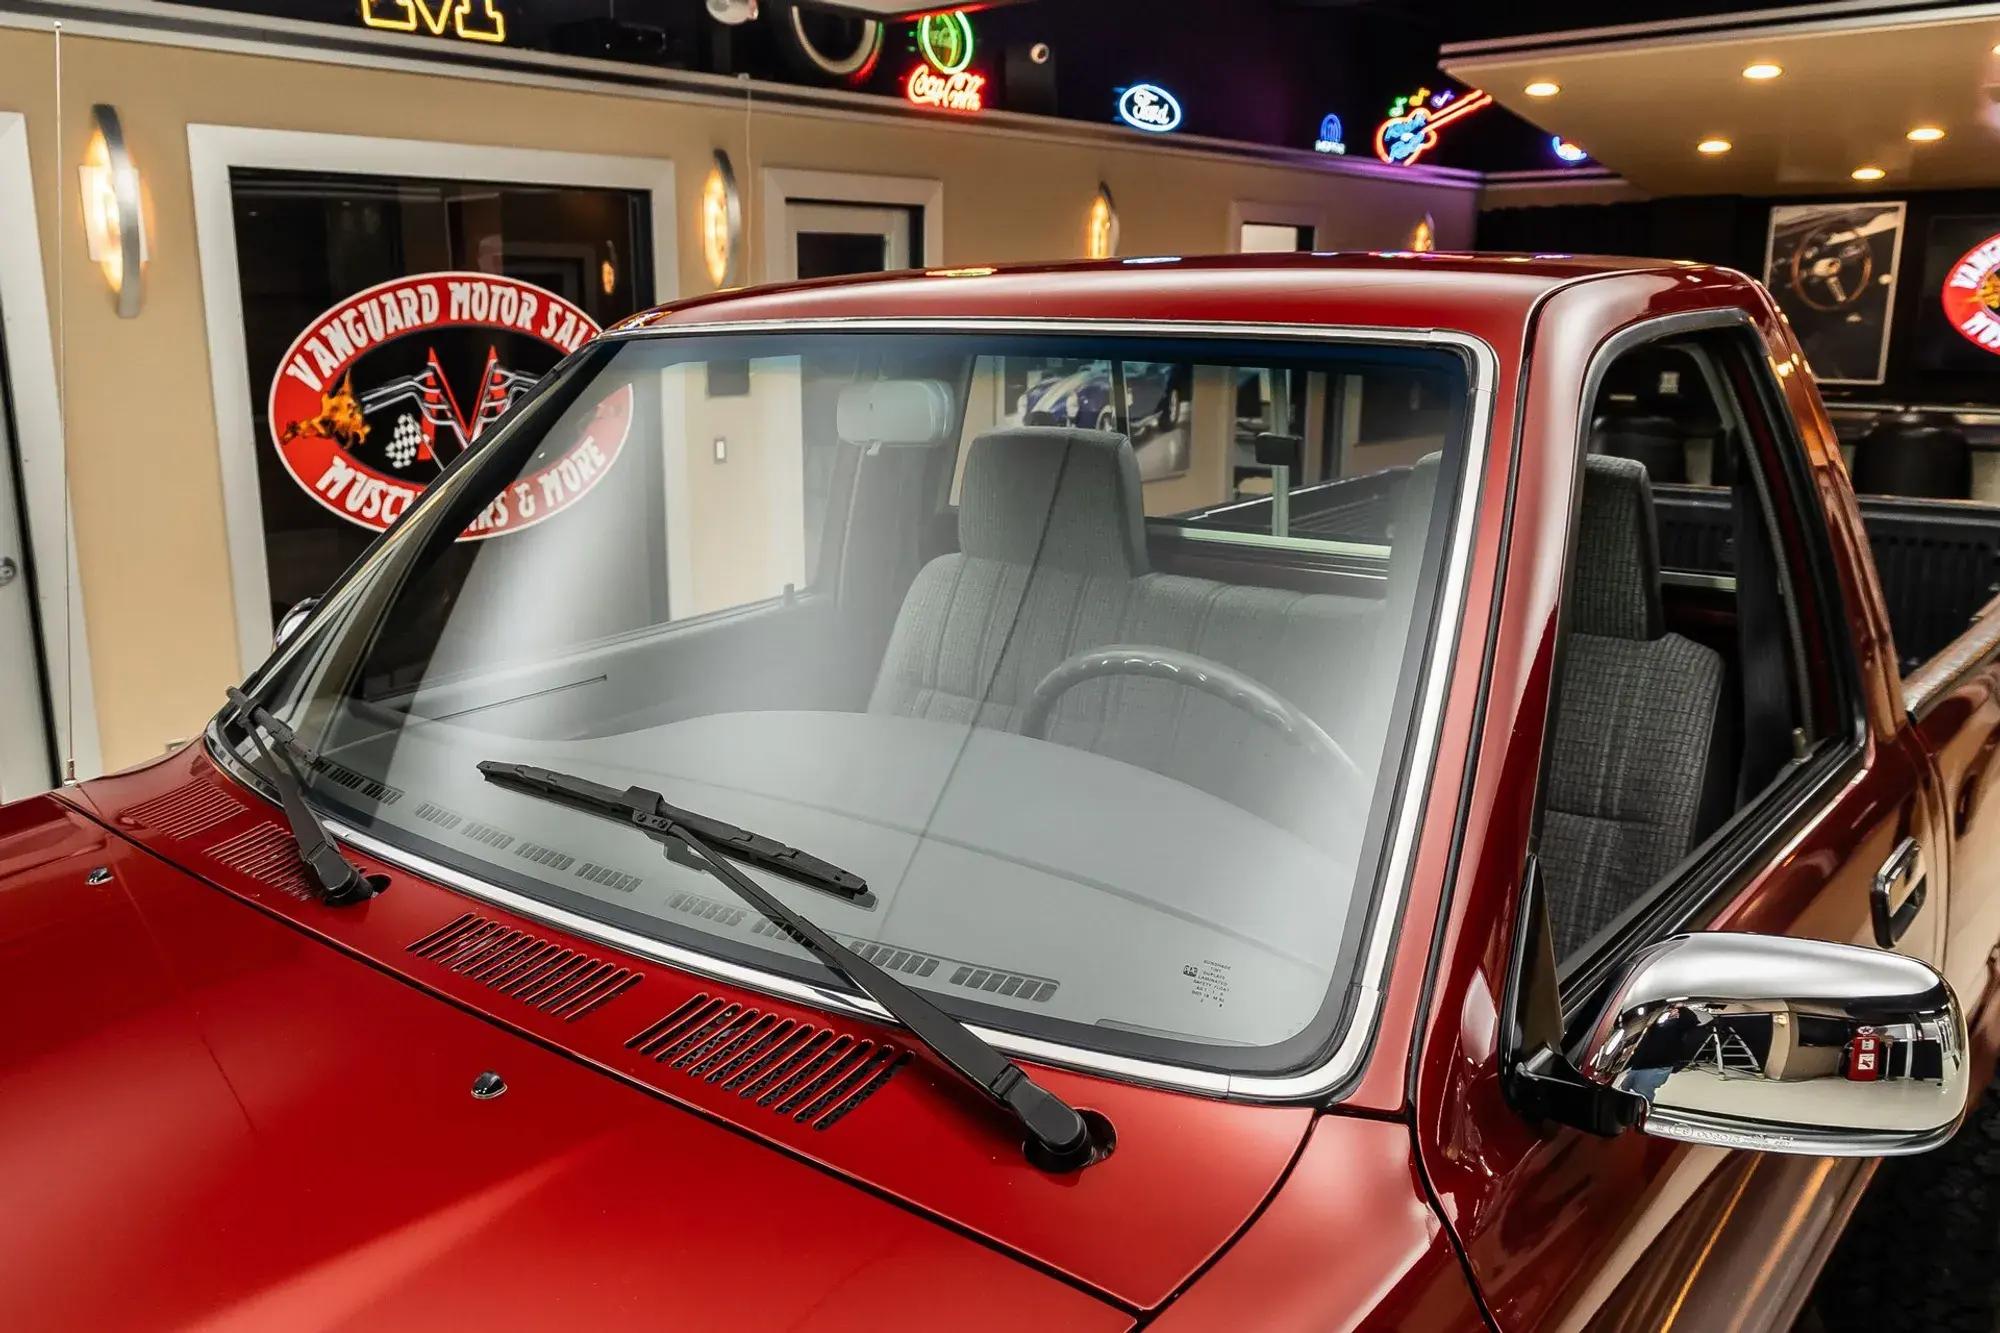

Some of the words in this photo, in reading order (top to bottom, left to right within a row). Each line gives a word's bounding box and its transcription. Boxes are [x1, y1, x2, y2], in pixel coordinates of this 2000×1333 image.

[285, 284, 440, 392] VANGUARD
[448, 281, 538, 330] MOTOR
[540, 301, 598, 354] SAL
[514, 482, 536, 518] &
[537, 435, 606, 507] MORE
